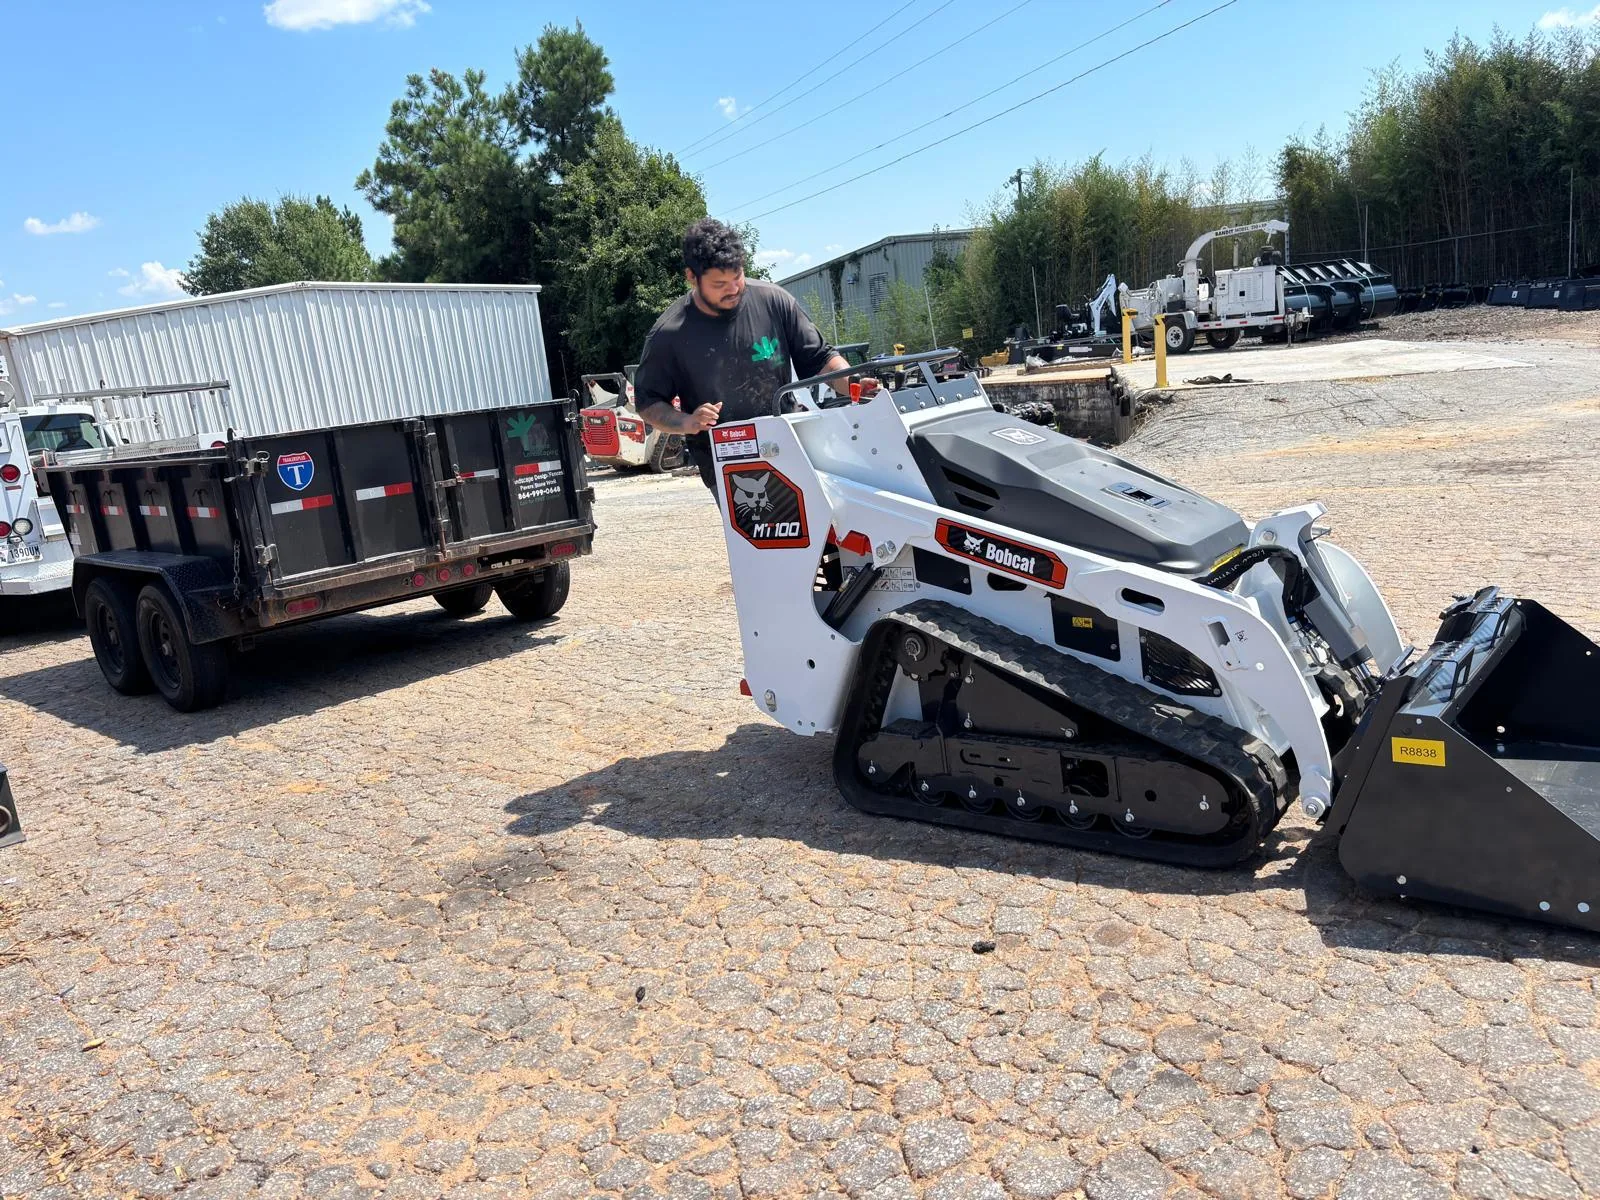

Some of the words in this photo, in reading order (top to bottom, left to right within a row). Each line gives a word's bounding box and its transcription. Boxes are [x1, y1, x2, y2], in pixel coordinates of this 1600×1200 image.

[287, 464, 305, 486] T
[985, 542, 1036, 574] Bobcat
[1400, 746, 1437, 758] R8838
